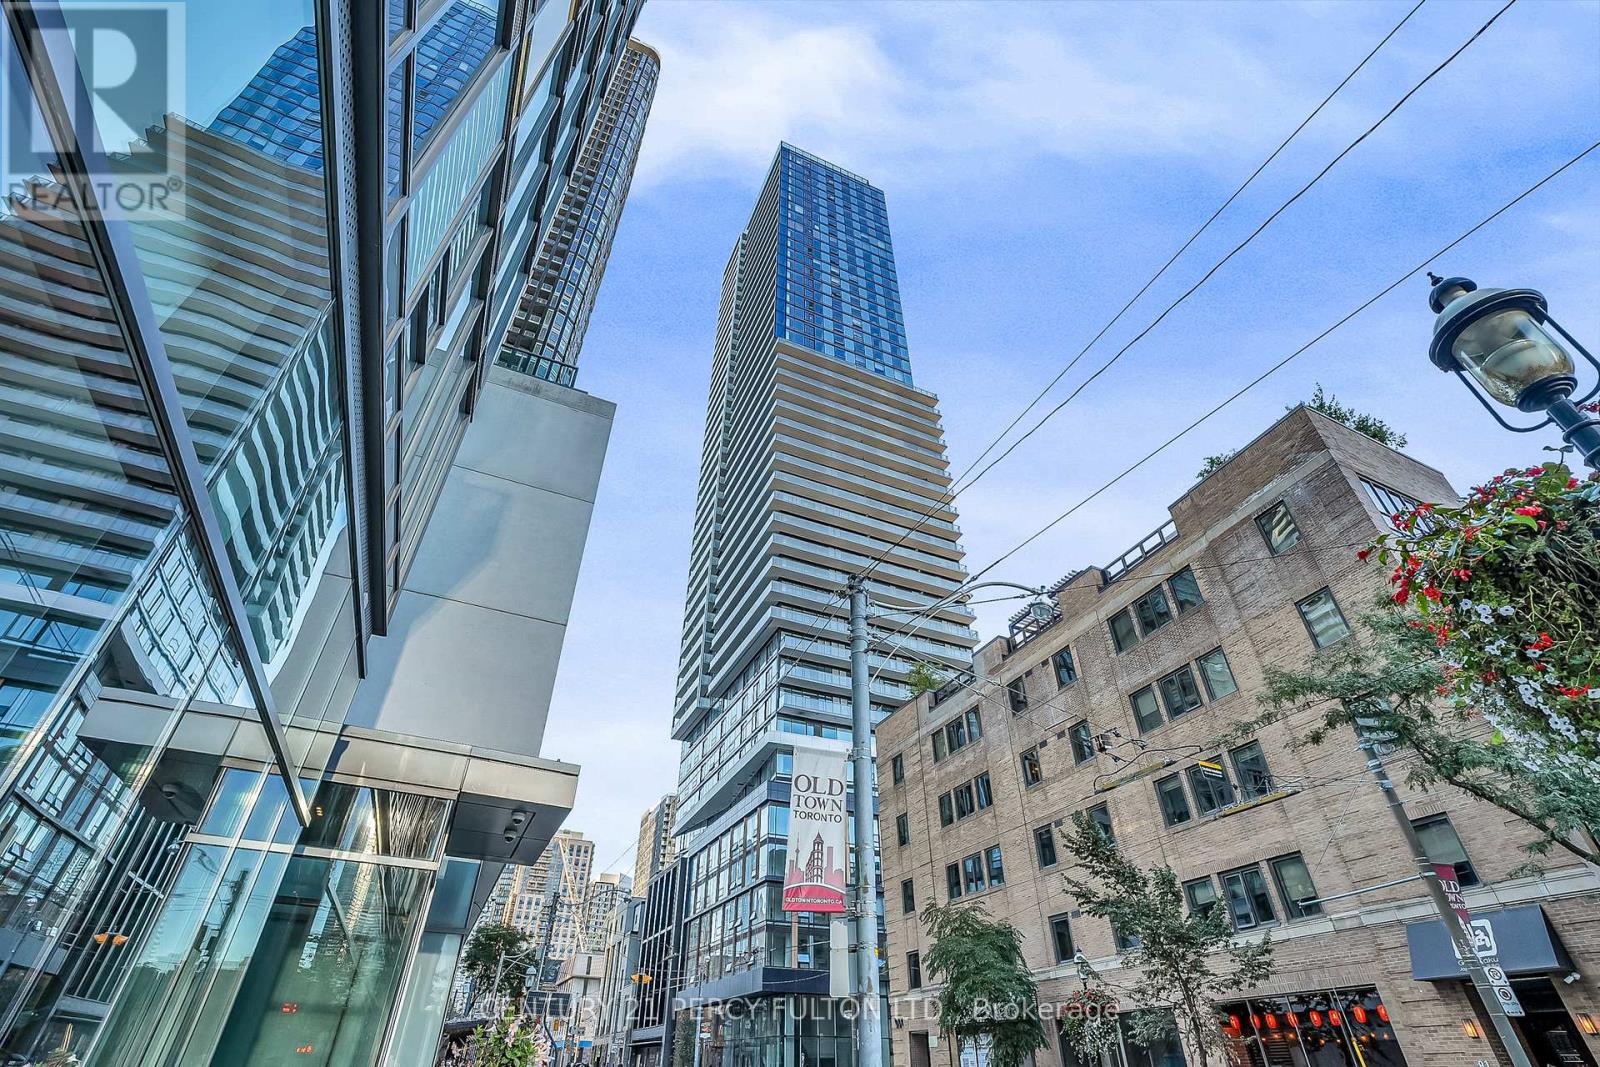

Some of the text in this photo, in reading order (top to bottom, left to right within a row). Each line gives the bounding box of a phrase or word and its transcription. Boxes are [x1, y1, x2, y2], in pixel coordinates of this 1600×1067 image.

[793, 774, 844, 796] OLD
[793, 794, 843, 813] TOWN
[793, 810, 843, 824] TORONTO
